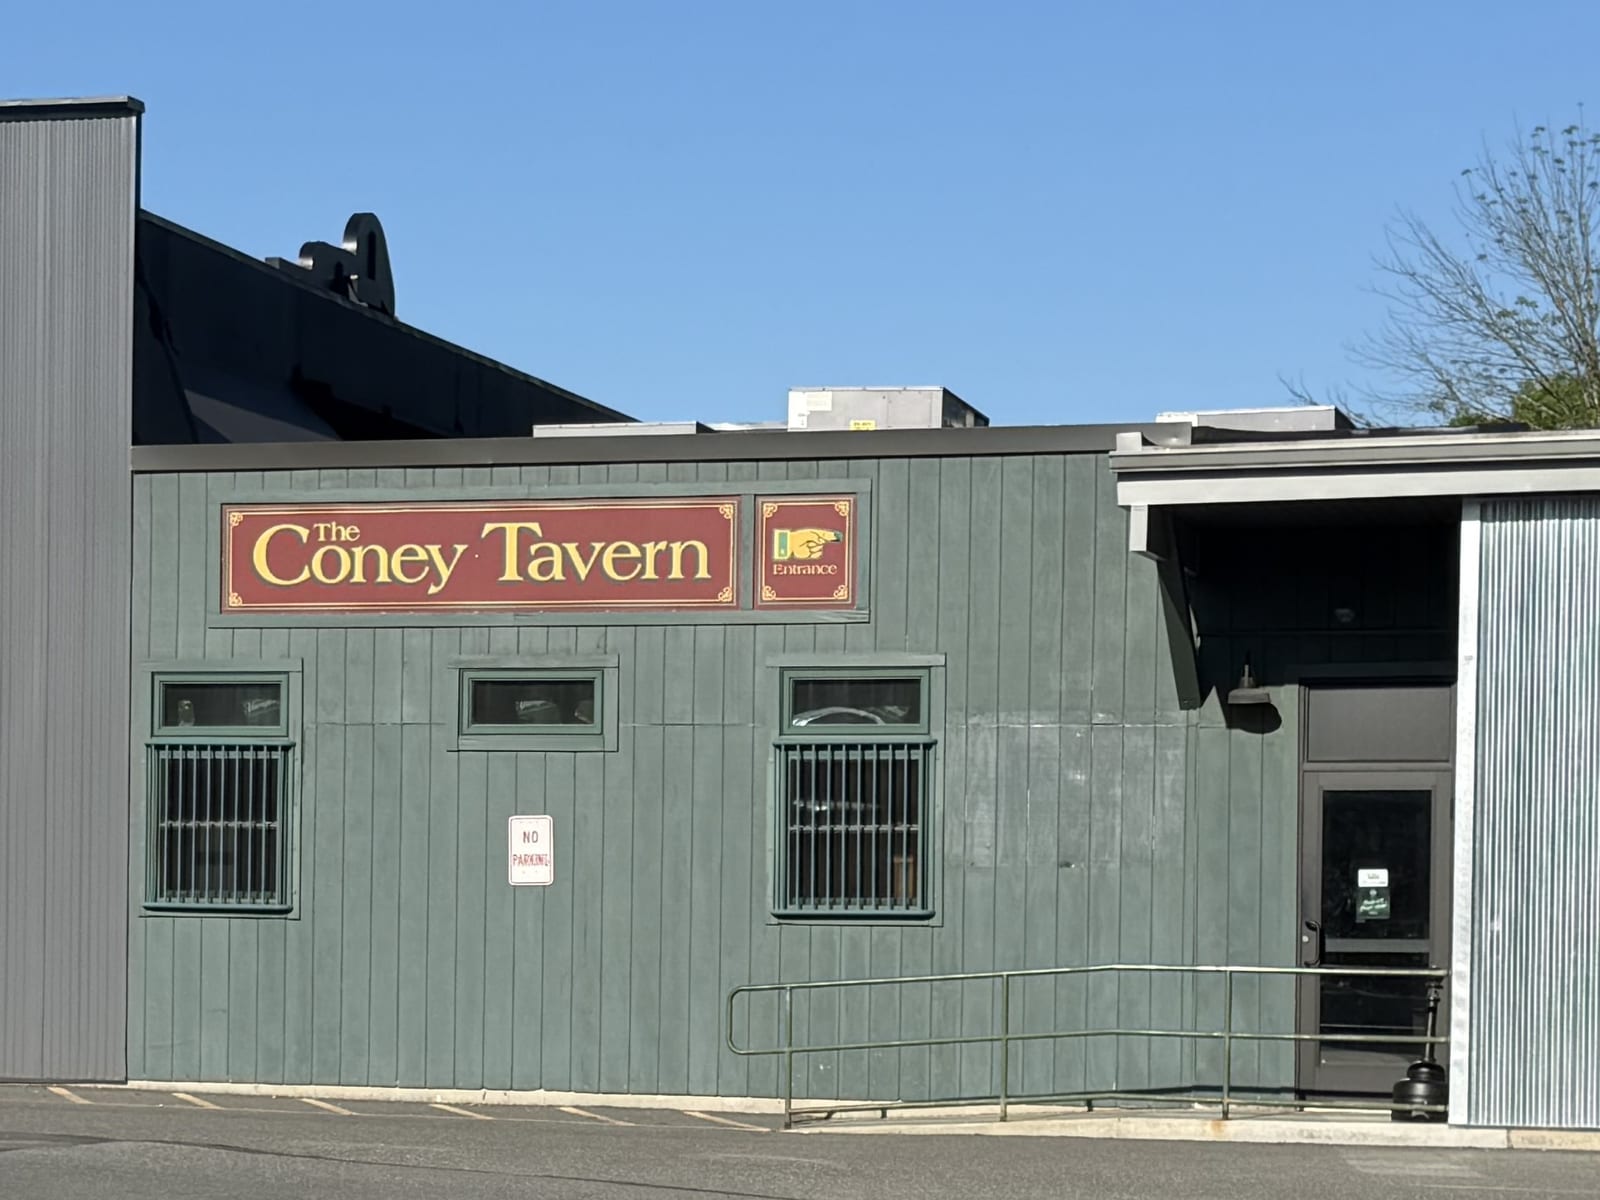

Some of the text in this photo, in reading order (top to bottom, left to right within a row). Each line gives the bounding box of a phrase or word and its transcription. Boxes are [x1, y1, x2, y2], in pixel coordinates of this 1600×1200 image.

[313, 521, 361, 541] The
[253, 521, 712, 595] Coney Tavern
[772, 563, 838, 575] Entrance
[522, 830, 539, 843] NO
